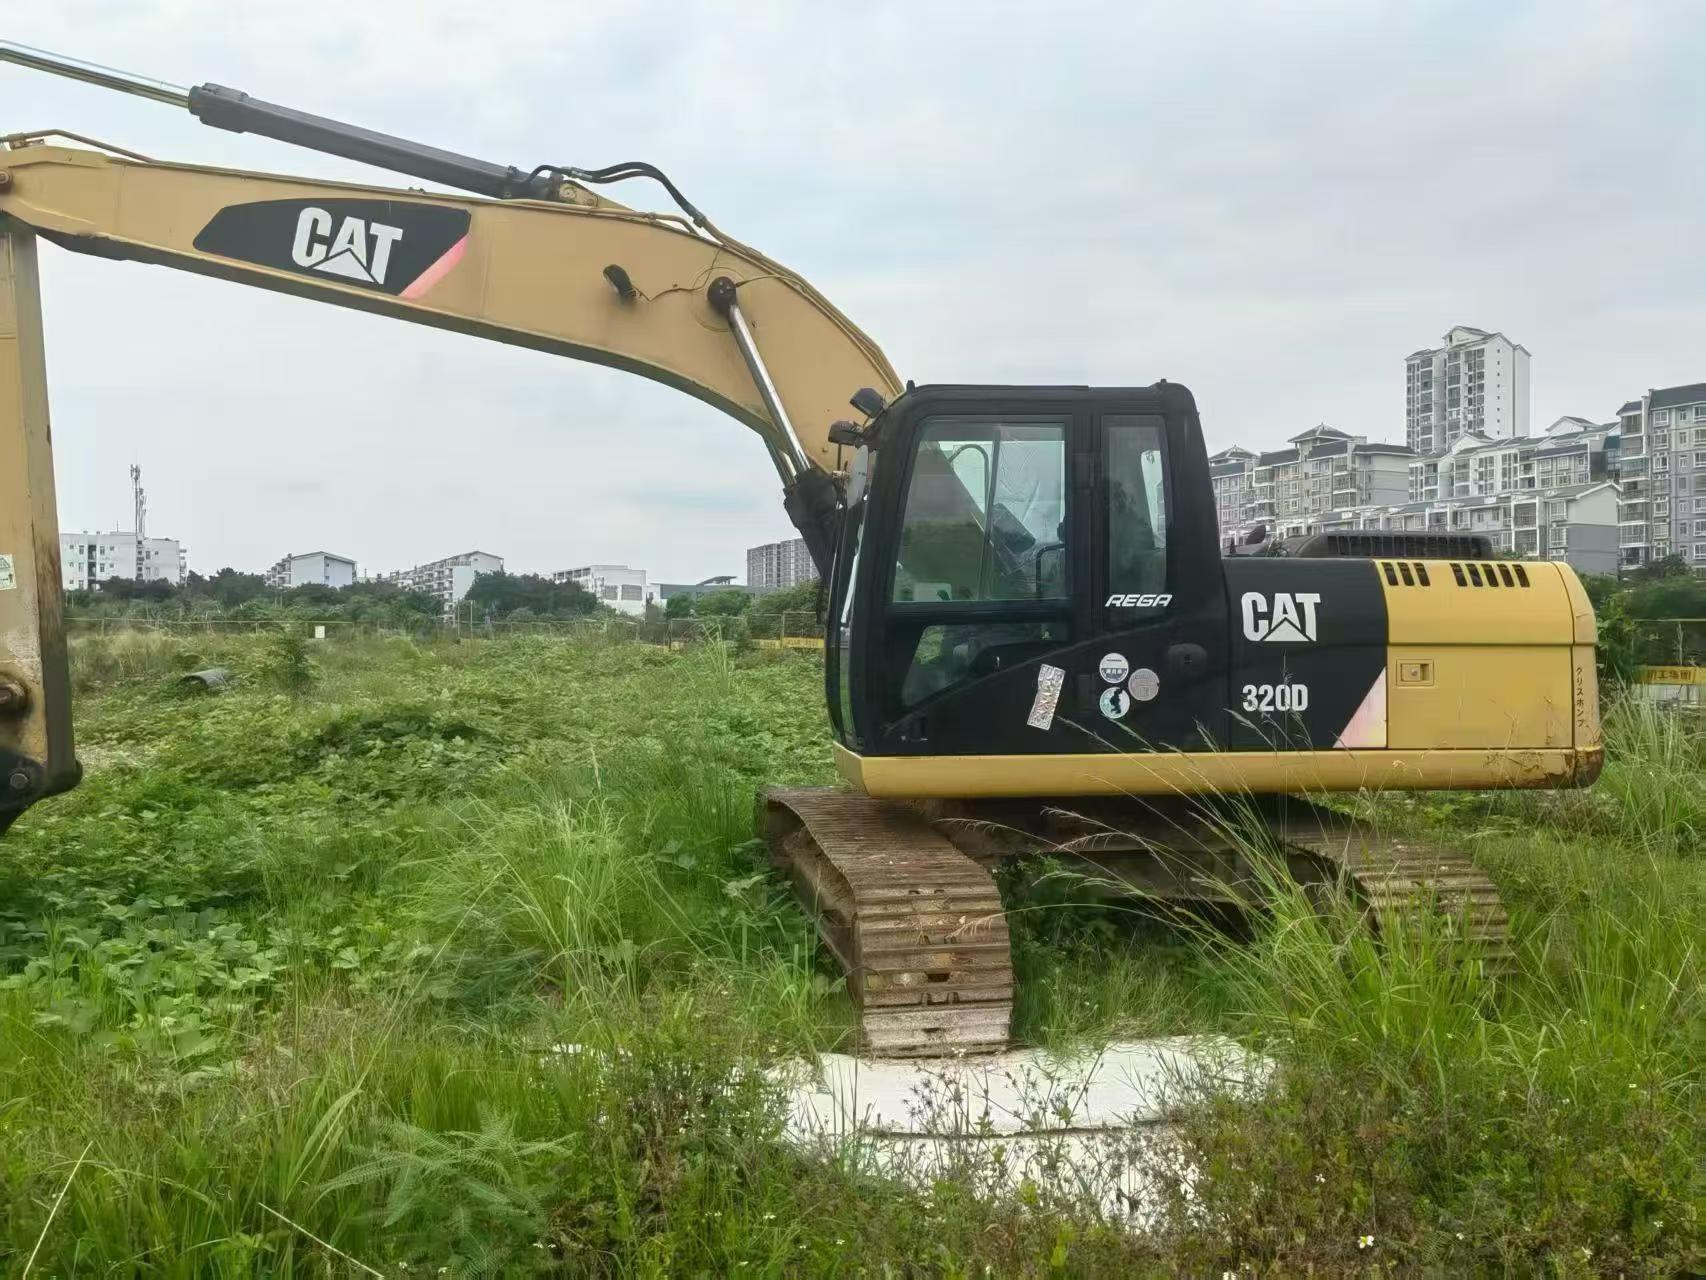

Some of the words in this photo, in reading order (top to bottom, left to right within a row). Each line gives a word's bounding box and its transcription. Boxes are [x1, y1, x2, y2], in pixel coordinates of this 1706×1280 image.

[292, 206, 403, 285] CAT
[1105, 594, 1173, 608] REGA
[1241, 591, 1321, 642] CAT
[1241, 684, 1309, 712] 320D
